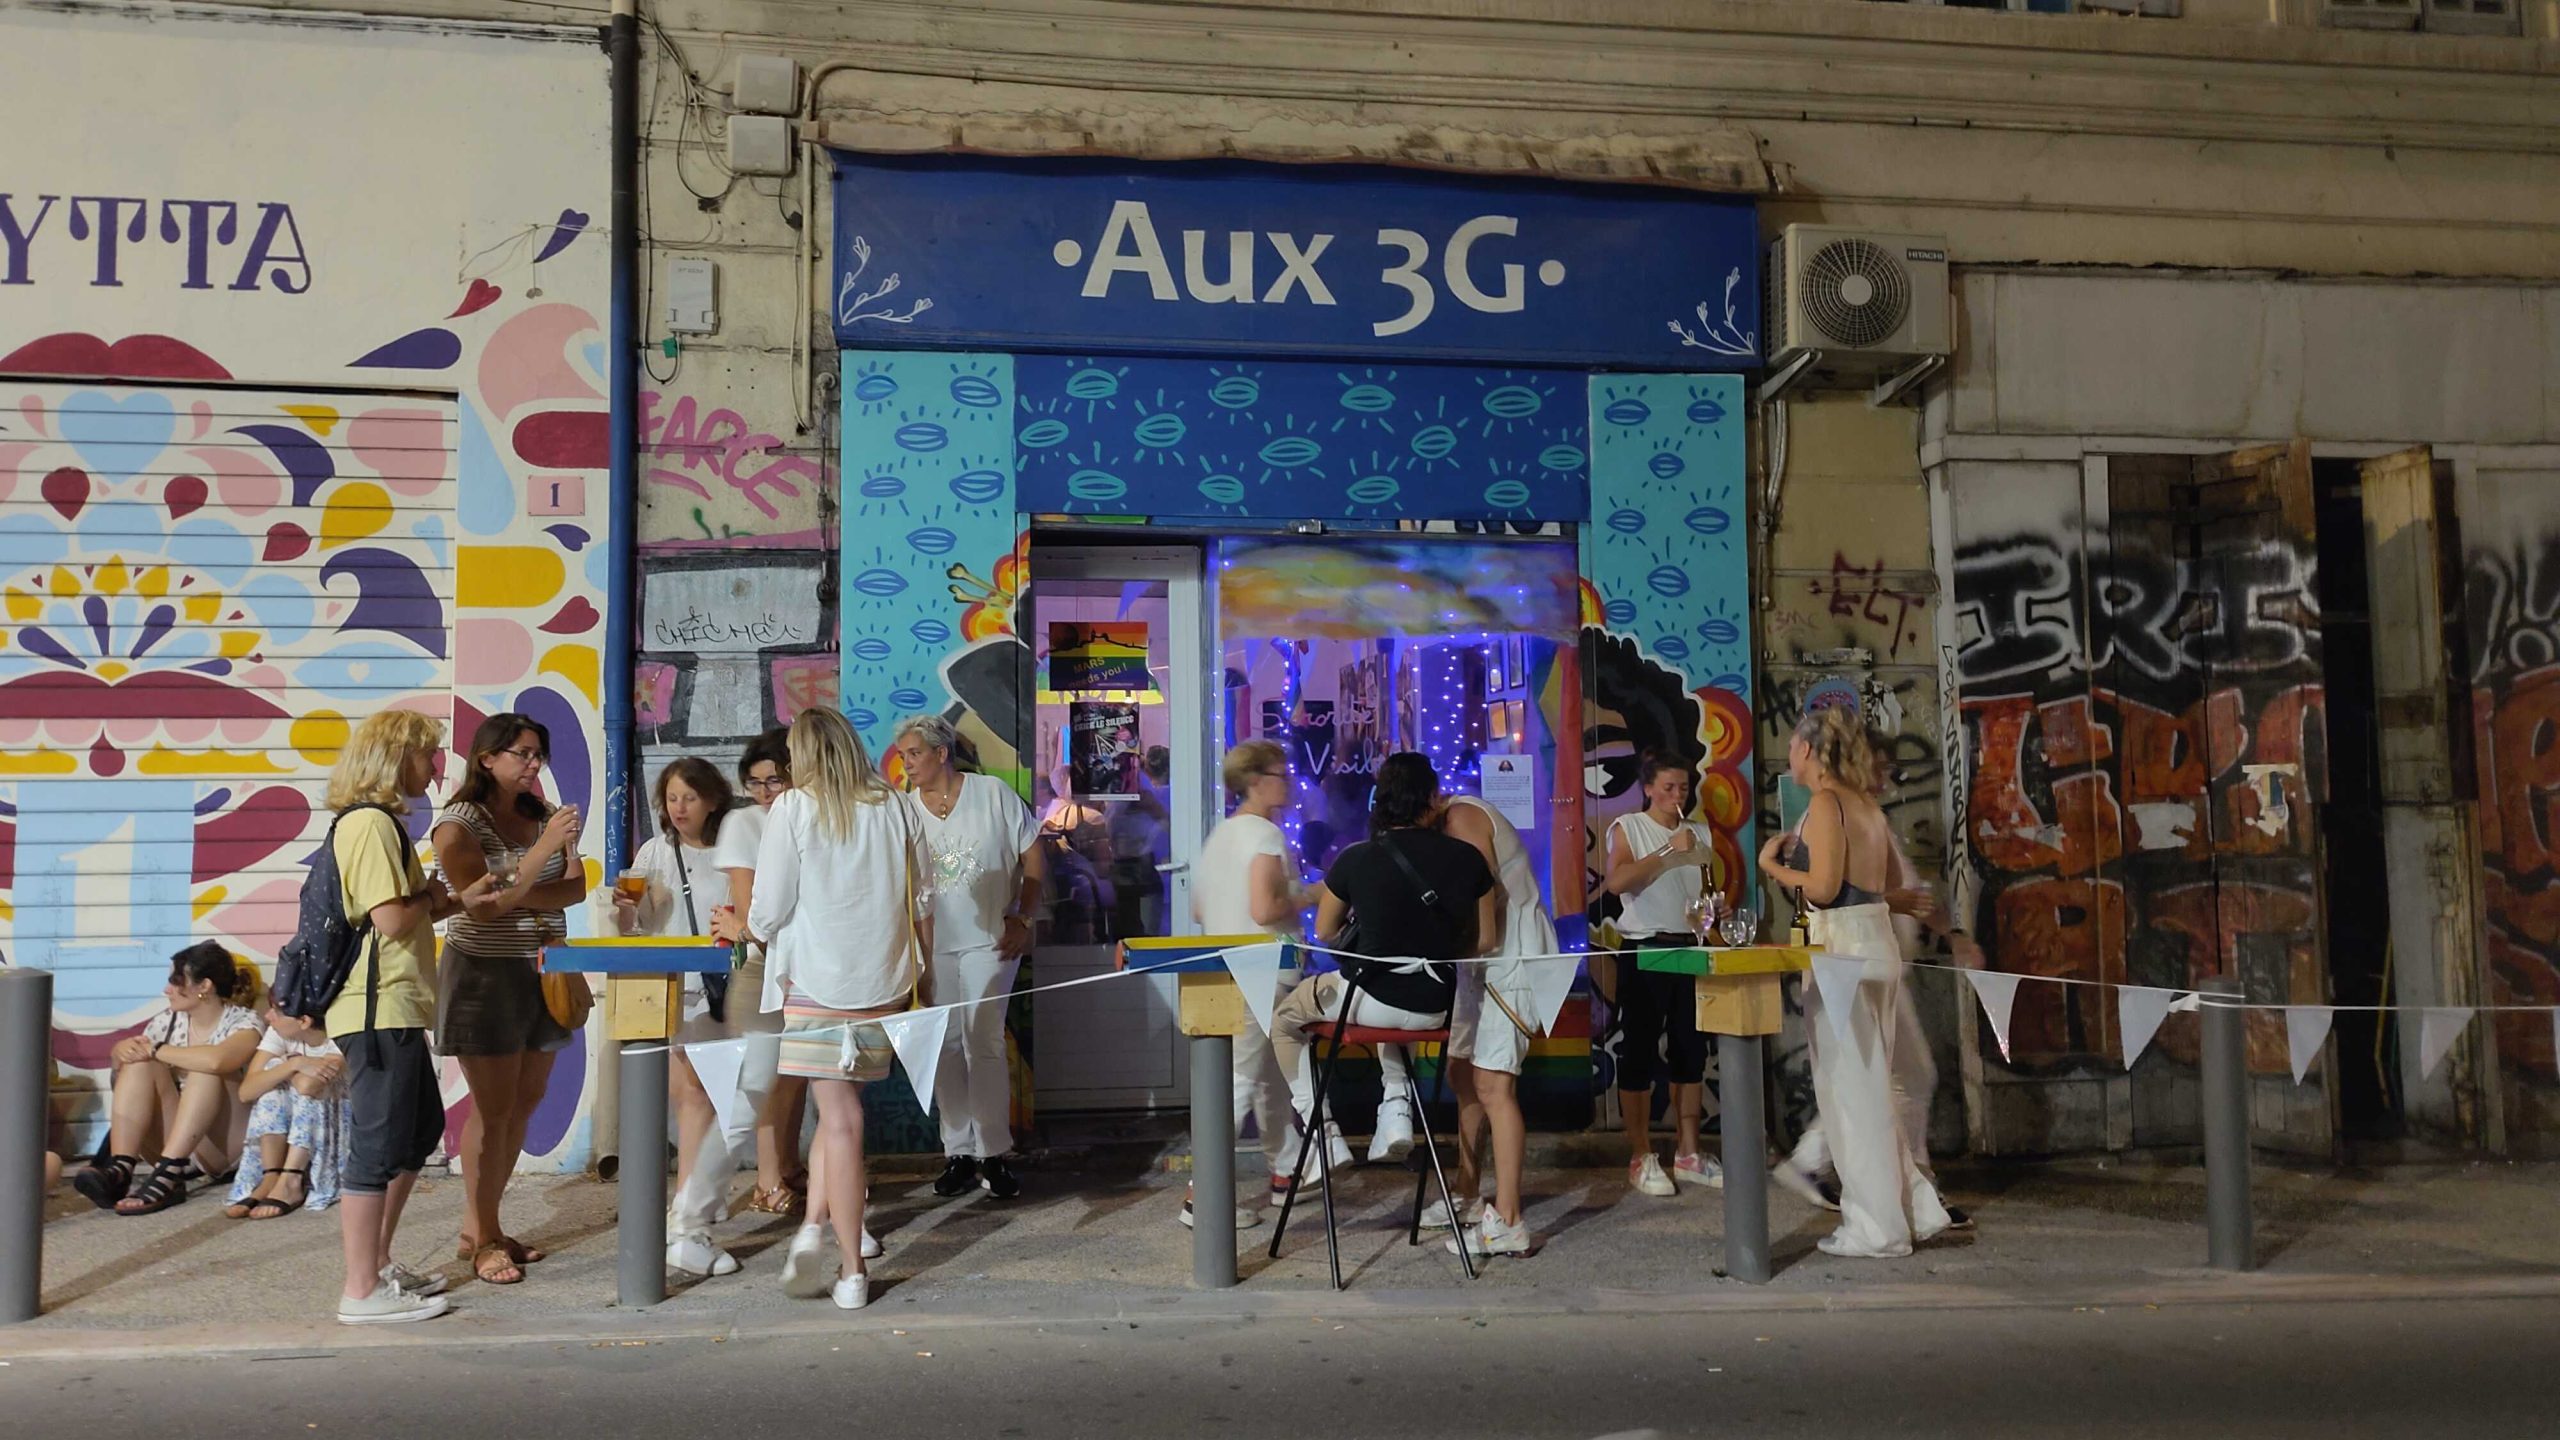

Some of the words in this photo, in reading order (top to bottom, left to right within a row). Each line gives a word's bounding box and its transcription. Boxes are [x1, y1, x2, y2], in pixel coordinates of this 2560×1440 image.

[1907, 250, 1943, 260] HITACHI
[1081, 199, 1337, 305] Aux
[1372, 214, 1526, 337] 3G
[1073, 657, 1105, 675] MARS
[1101, 666, 1121, 680] you
